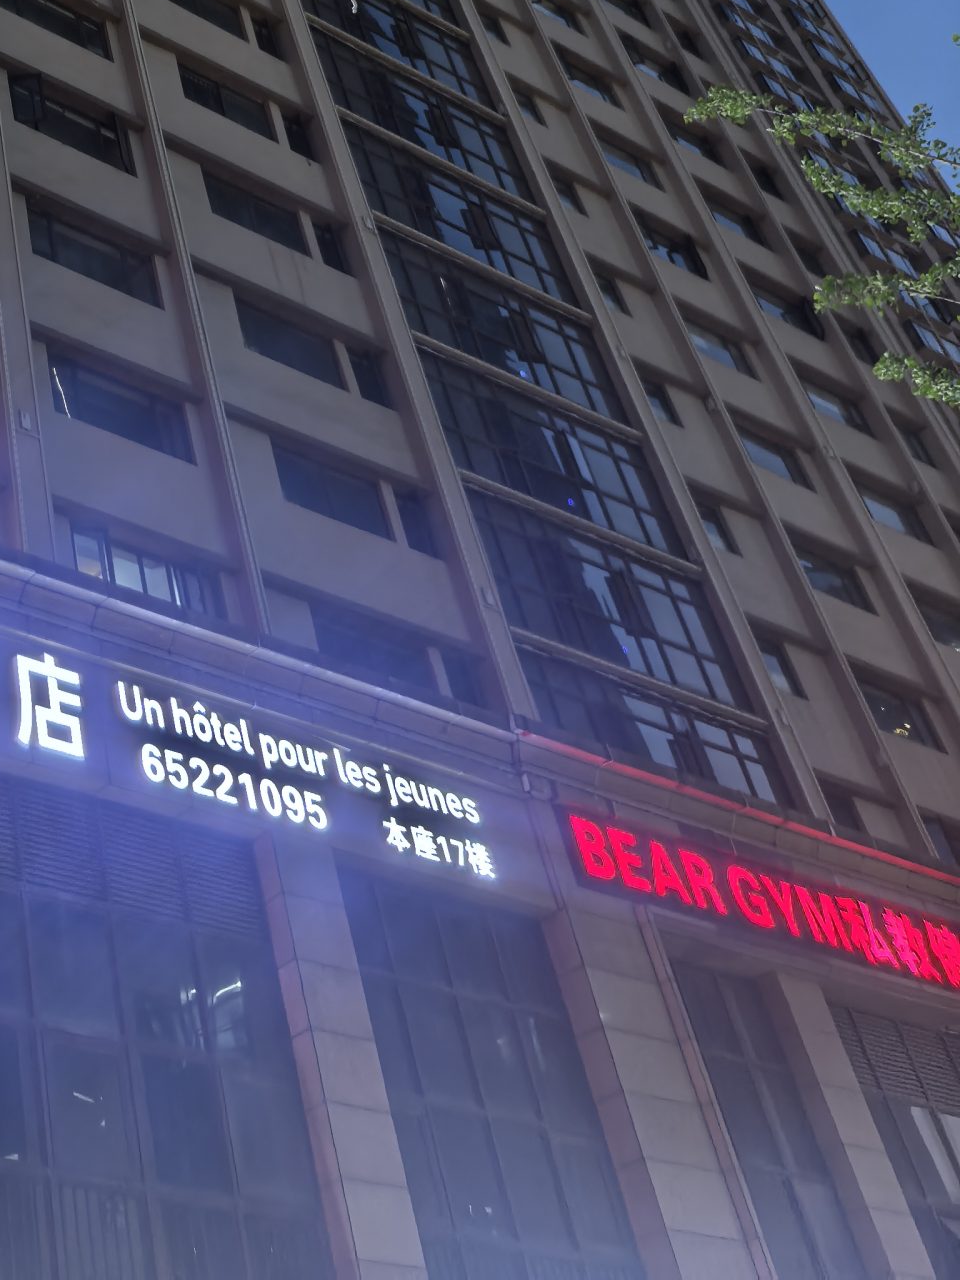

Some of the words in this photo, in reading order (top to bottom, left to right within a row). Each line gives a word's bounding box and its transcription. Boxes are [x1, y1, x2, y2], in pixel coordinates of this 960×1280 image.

[117, 680, 166, 729] Un
[169, 696, 256, 756] hôtel
[257, 731, 329, 778] pour
[332, 746, 382, 794] les
[383, 763, 481, 825] jeunes
[140, 743, 329, 831] 65221095
[381, 815, 497, 880] 本座17楼
[569, 814, 728, 916] BEAR
